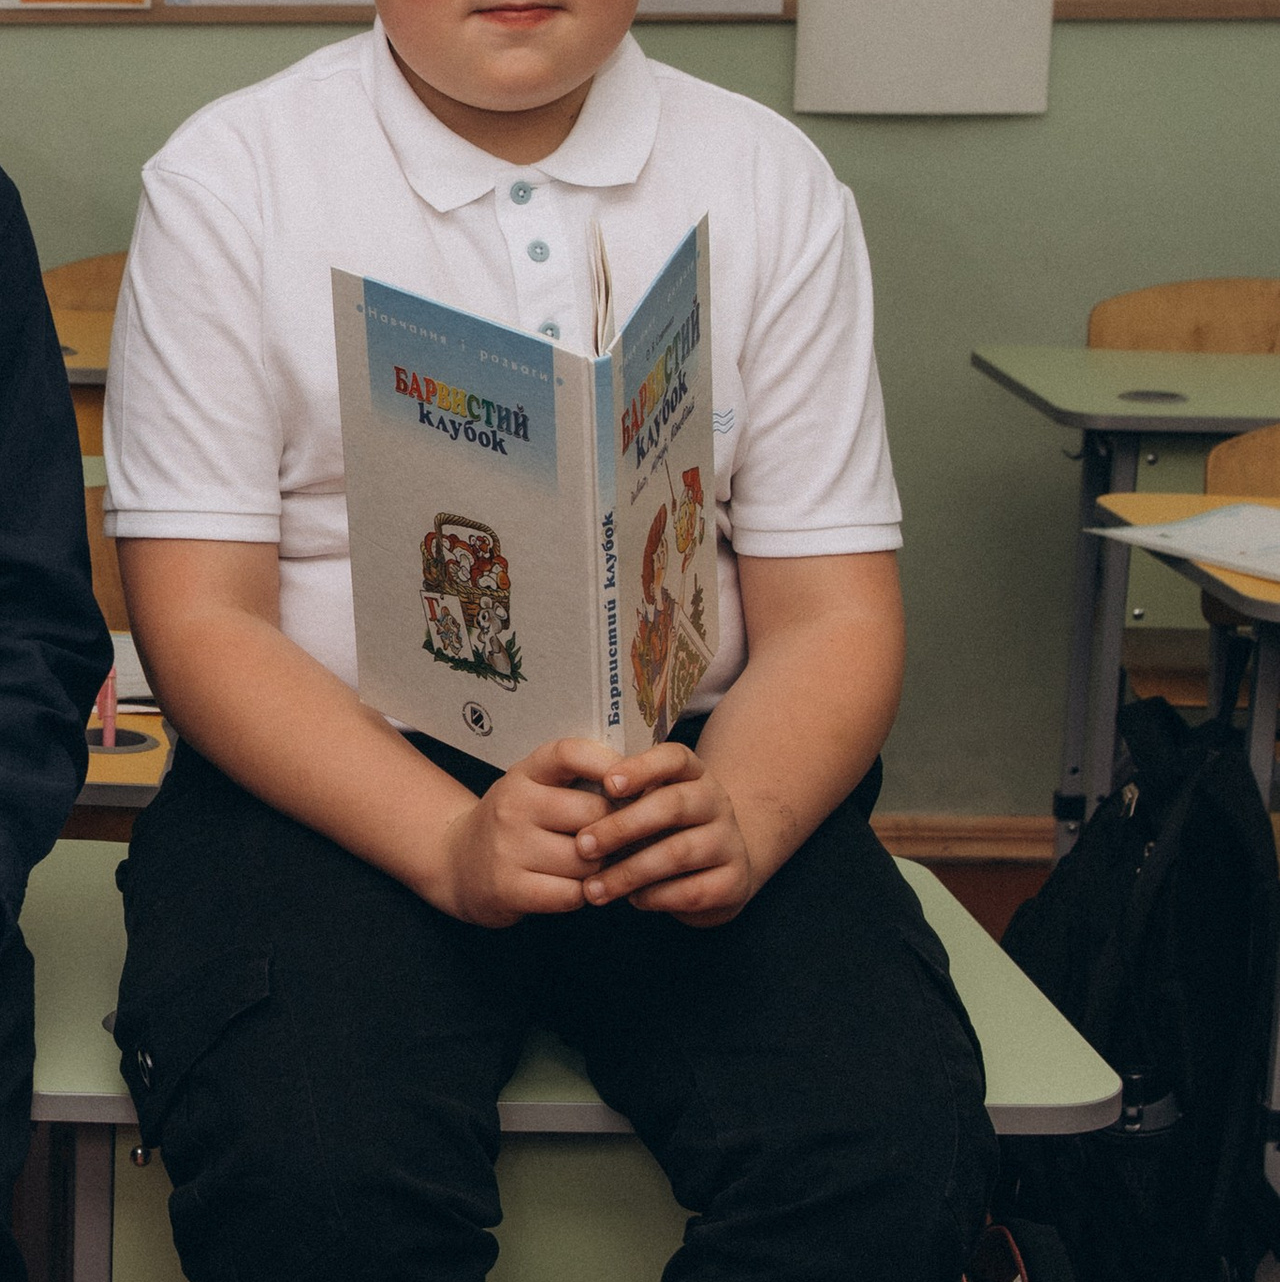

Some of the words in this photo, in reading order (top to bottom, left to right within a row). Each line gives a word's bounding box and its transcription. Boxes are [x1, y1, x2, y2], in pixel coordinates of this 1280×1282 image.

[367, 306, 449, 347] Навчання
[479, 347, 550, 384] розваги
[622, 293, 701, 457] БАРВИСТИЙ
[393, 365, 531, 443] БАРВИСТИЙ
[417, 401, 509, 457] клубок
[601, 510, 617, 591] клубок
[606, 599, 622, 728] Барвистий
